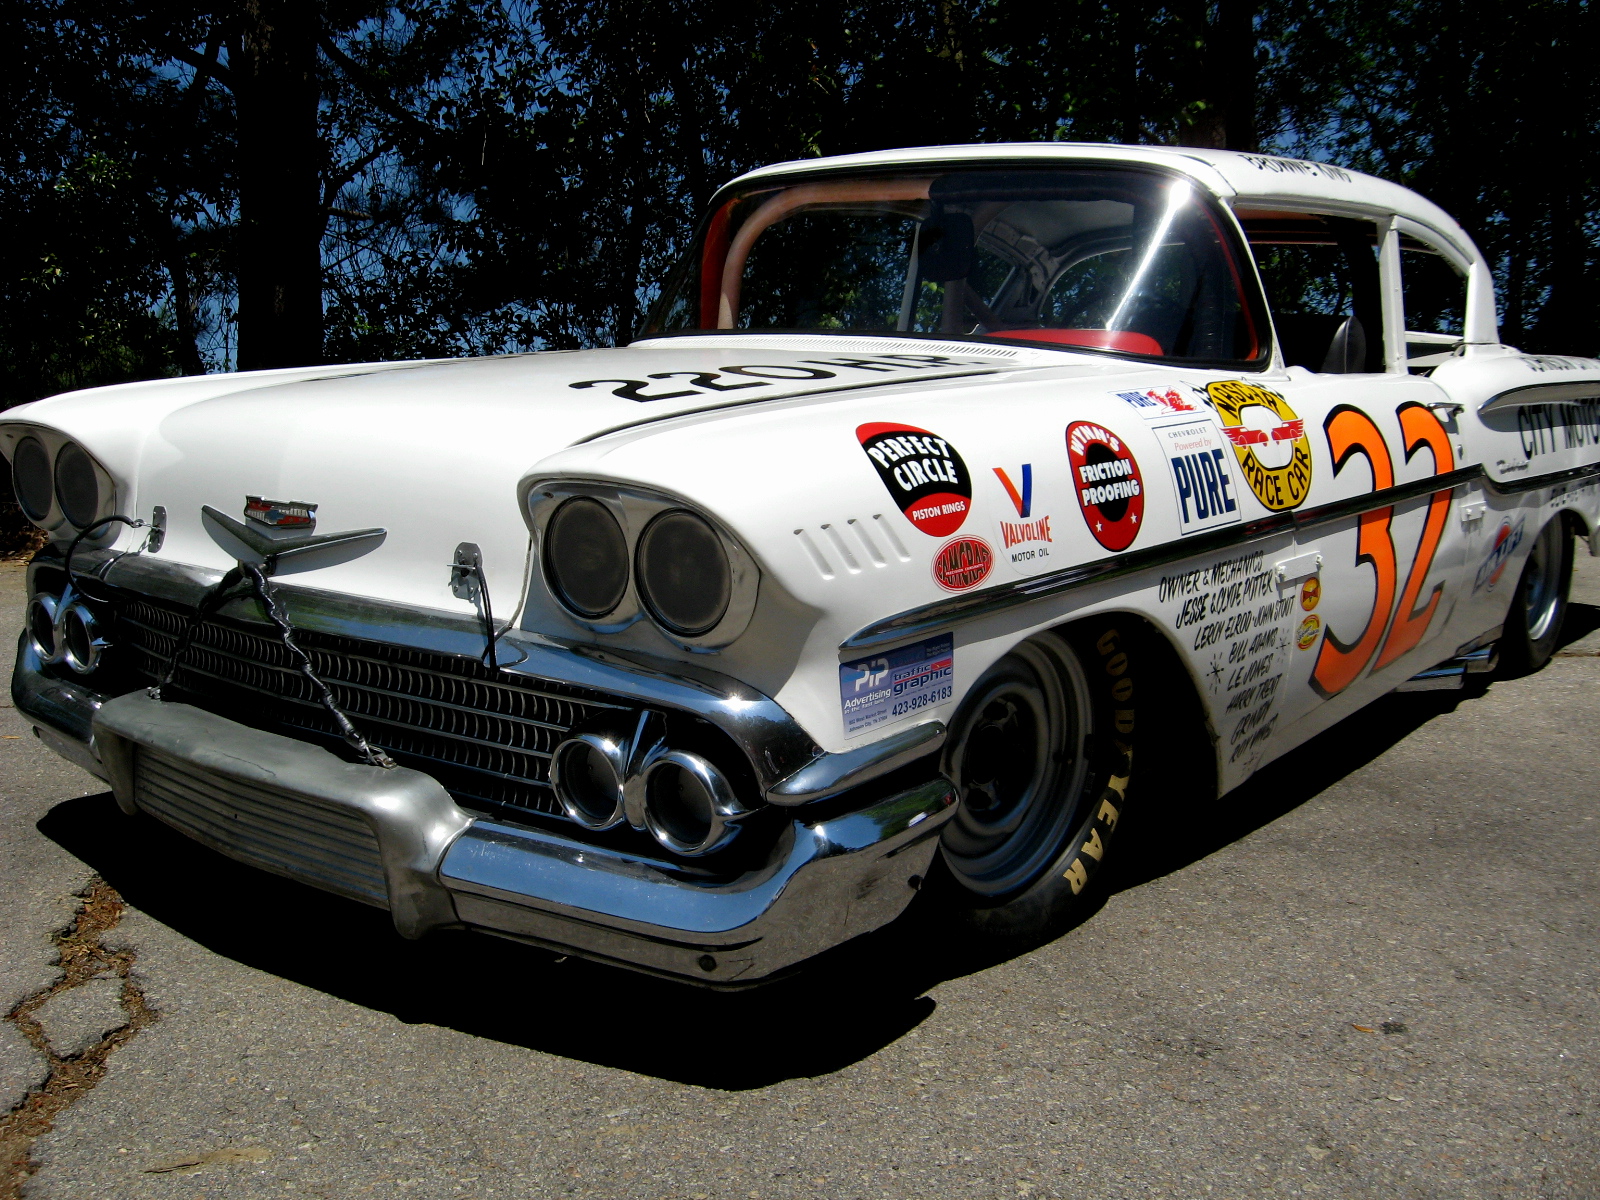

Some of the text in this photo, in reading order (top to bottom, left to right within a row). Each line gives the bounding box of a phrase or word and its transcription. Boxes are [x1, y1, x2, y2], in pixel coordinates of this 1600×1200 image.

[568, 365, 837, 403] 220
[1115, 391, 1158, 409] PURE
[1216, 381, 1282, 420] NASCAR
[1071, 425, 1120, 456] WYNN'S
[1168, 426, 1208, 439] CHEVROLET
[1174, 437, 1212, 452] Powered by
[867, 435, 950, 469] PERFECT
[893, 458, 959, 492] CIRCLE
[1079, 458, 1133, 484] FRICTION
[1170, 448, 1237, 524] PURE
[1242, 446, 1309, 506] RACE CAR
[1081, 479, 1140, 507] PROOFING
[912, 500, 966, 522] PISTON RINGS
[1000, 515, 1053, 549] VALVOLINE
[1011, 548, 1050, 563] MOTOR OIL
[1308, 400, 1455, 700] 32
[1158, 550, 1264, 603] OWNER & MECHANICS
[1175, 593, 1210, 629] JESSE
[1216, 581, 1243, 616] CLYDE
[1243, 569, 1274, 602] POTTER
[1193, 620, 1223, 651] LEROY
[1224, 609, 1251, 640] ELROD
[1228, 640, 1248, 664] BILL
[893, 663, 931, 681] traffic
[893, 666, 952, 696] graphic
[1243, 653, 1274, 684] JONES
[844, 688, 892, 710] Advertising
[891, 685, 953, 717] 423-928-6183
